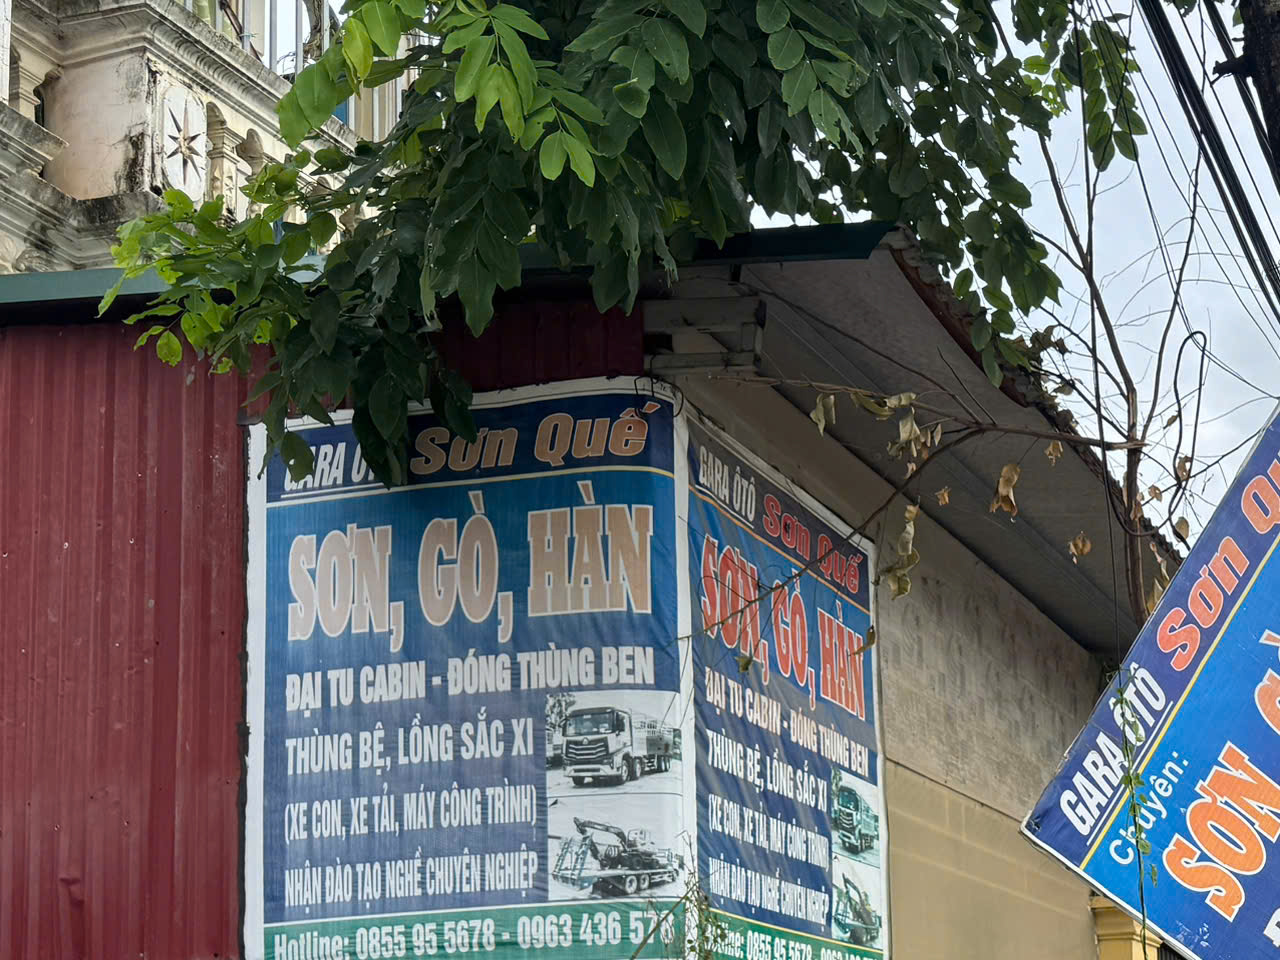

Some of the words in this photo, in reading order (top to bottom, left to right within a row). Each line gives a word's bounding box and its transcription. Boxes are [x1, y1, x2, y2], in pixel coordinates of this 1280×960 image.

[284, 442, 346, 491] RA
[410, 426, 518, 475] Sơn
[534, 402, 661, 467] Quế
[699, 446, 729, 504] GARA
[733, 466, 756, 521] ÔTÔ
[763, 494, 810, 561] Sơn
[818, 534, 864, 593] Quế
[288, 523, 405, 652] SƠN,
[418, 490, 514, 643] GÒ,
[527, 480, 654, 616] HÀN
[1157, 535, 1250, 672] Sơn
[701, 533, 769, 686] SƠN,
[771, 568, 816, 711] GÒ,
[817, 600, 865, 721] HÀN
[285, 671, 322, 718] ĐẠI
[328, 668, 354, 707] TU
[359, 660, 426, 704] CABIN
[447, 648, 512, 697] ĐÓNG
[517, 642, 595, 690] THÙNG
[601, 645, 655, 686] BEN
[285, 728, 353, 776] THÙNG
[359, 722, 392, 781] BỆ,
[398, 713, 453, 765] LỒNG
[460, 706, 505, 761] SẮC
[511, 717, 534, 757] XI
[705, 666, 725, 715] ĐẠI
[728, 679, 743, 718] TU
[746, 688, 781, 736] CABIN
[790, 707, 817, 753] ĐÓNG
[818, 723, 849, 769] THÙNG
[850, 740, 869, 777] BEN
[1060, 731, 1129, 836] GARA
[1108, 661, 1166, 747] ÔTÔ
[706, 728, 744, 779] THÙNG
[746, 744, 764, 793] BỆ,
[766, 748, 793, 800] LỒNG
[796, 760, 816, 807] SẮC
[817, 778, 828, 812] XI
[1109, 751, 1189, 865] Chuyên:
[284, 802, 308, 845] (XE
[311, 800, 346, 839] CON,
[350, 797, 369, 835] XE
[372, 782, 400, 838] TẢI,
[403, 786, 436, 829] MÁY
[439, 779, 483, 827] CÔNG
[485, 778, 537, 826] TRÌNH)
[743, 806, 754, 843] XE
[769, 812, 786, 855] MÁY
[284, 860, 322, 914] NHẬN
[324, 858, 352, 902] ĐÀO
[355, 864, 382, 909] TẠO
[385, 846, 423, 898] NGHỀ
[425, 847, 482, 897] CHUYÊN
[484, 843, 538, 898] NGHIỆP
[747, 869, 760, 914] TẠO
[356, 925, 406, 960] 0855
[412, 922, 437, 956] 95
[443, 918, 496, 952] 5678
[517, 913, 572, 949] 0963
[579, 911, 621, 946] 436
